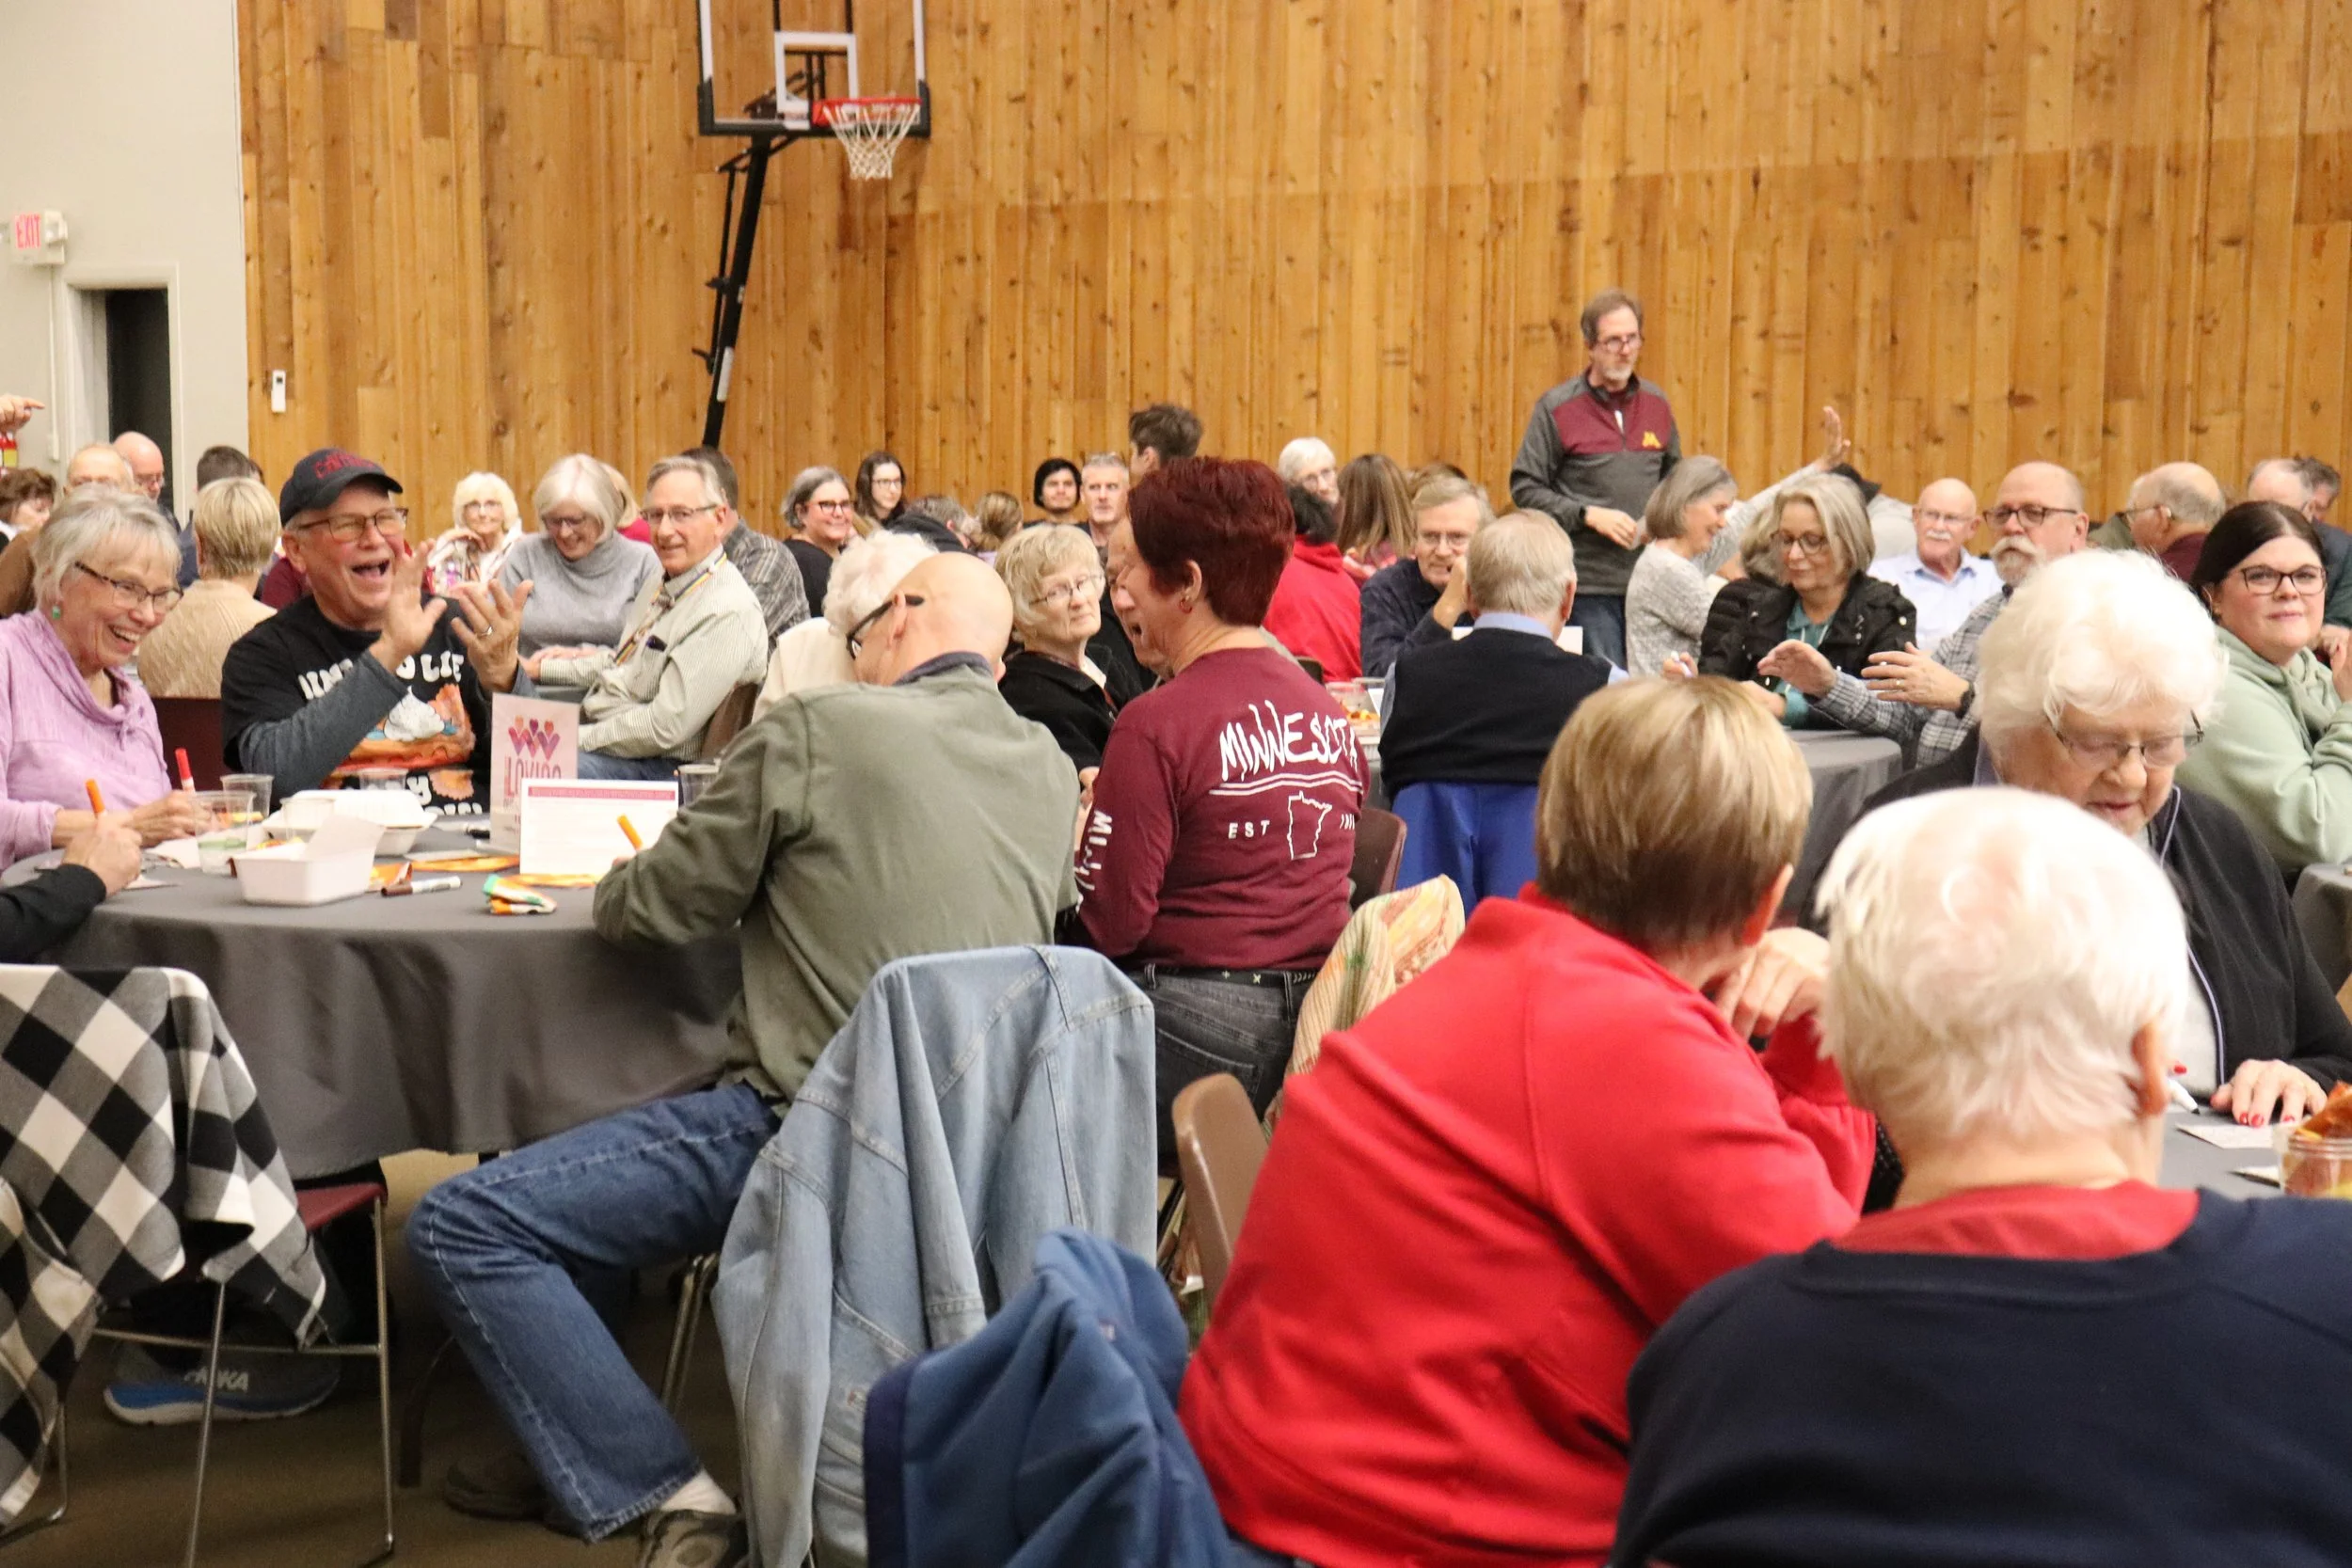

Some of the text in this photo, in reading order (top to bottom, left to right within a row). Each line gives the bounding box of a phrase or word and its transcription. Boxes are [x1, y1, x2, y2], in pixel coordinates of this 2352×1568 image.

[15, 214, 41, 249] EXIT
[1219, 699, 1359, 782] MINNESOTA
[1228, 819, 1270, 839] EST
